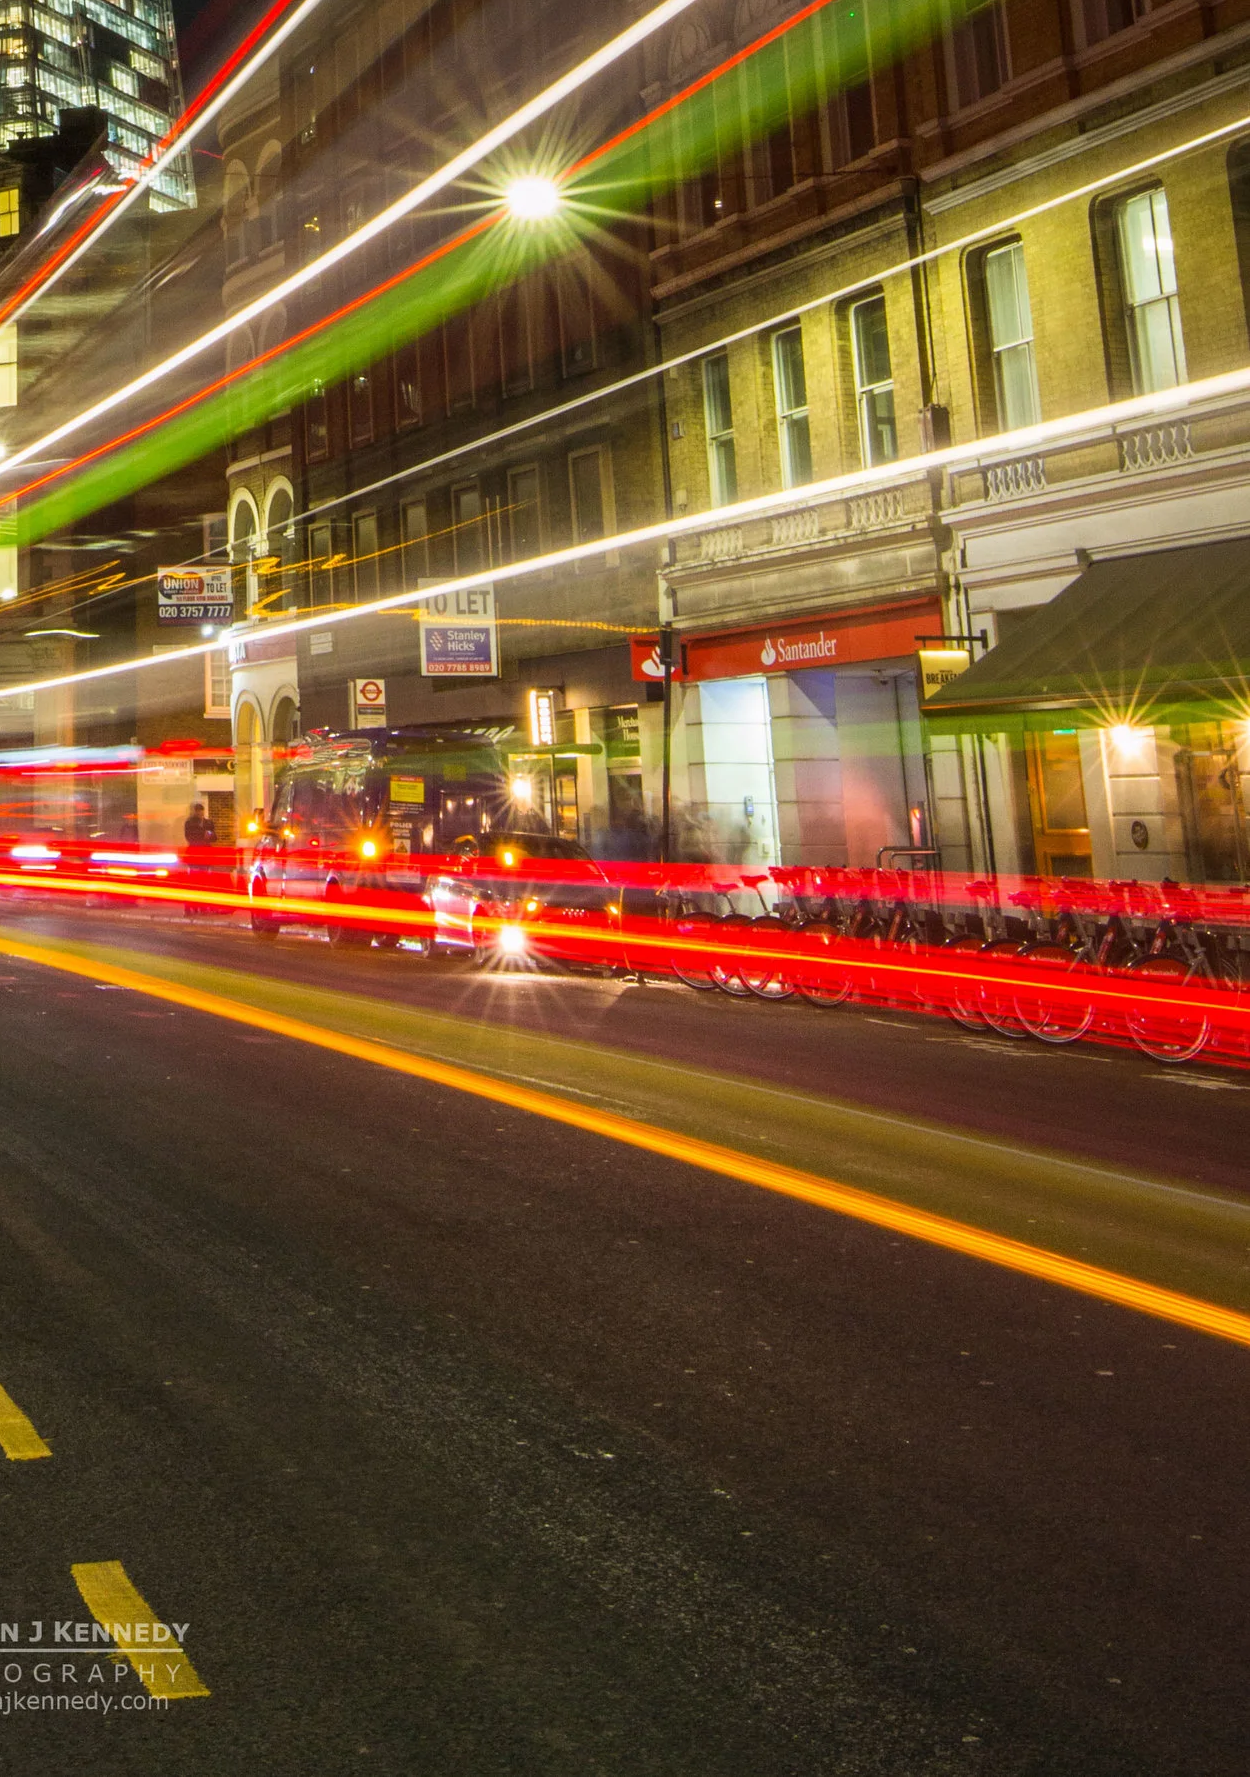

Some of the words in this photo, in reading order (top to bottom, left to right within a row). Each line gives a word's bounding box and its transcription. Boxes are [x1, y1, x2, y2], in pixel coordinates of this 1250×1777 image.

[163, 577, 199, 589] UNION
[206, 583, 214, 593] TO
[216, 583, 227, 593] LET
[455, 590, 490, 615] LET
[159, 606, 178, 618] 020
[179, 606, 204, 618] 3757
[207, 605, 231, 617] 7777
[447, 630, 486, 643] Stanley
[447, 641, 475, 651] Hicks
[777, 631, 837, 663] Santander
[429, 664, 445, 672] 020
[469, 664, 490, 672] 8989
